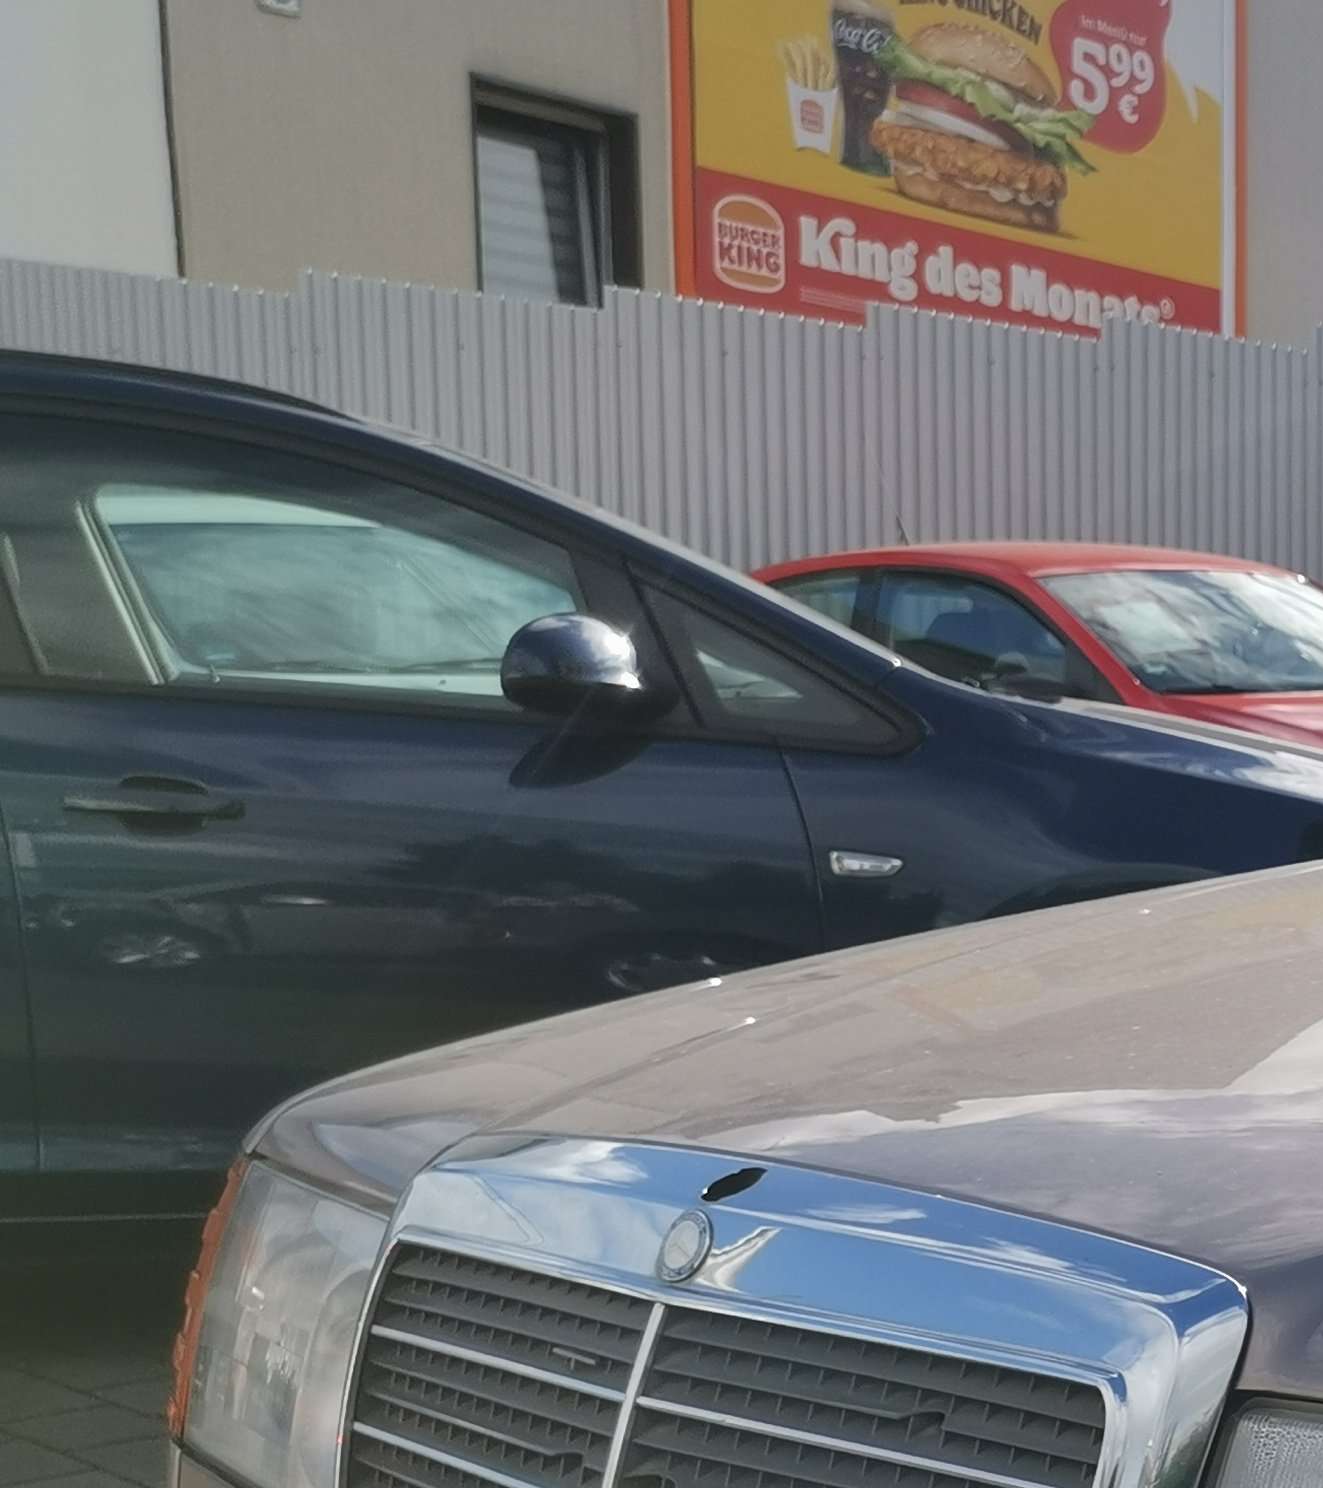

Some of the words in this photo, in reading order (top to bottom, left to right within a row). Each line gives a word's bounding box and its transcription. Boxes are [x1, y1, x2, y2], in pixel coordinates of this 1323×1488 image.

[717, 220, 782, 250] BURGER
[718, 241, 782, 274] KING
[799, 215, 919, 301] King
[924, 244, 1003, 308] des
